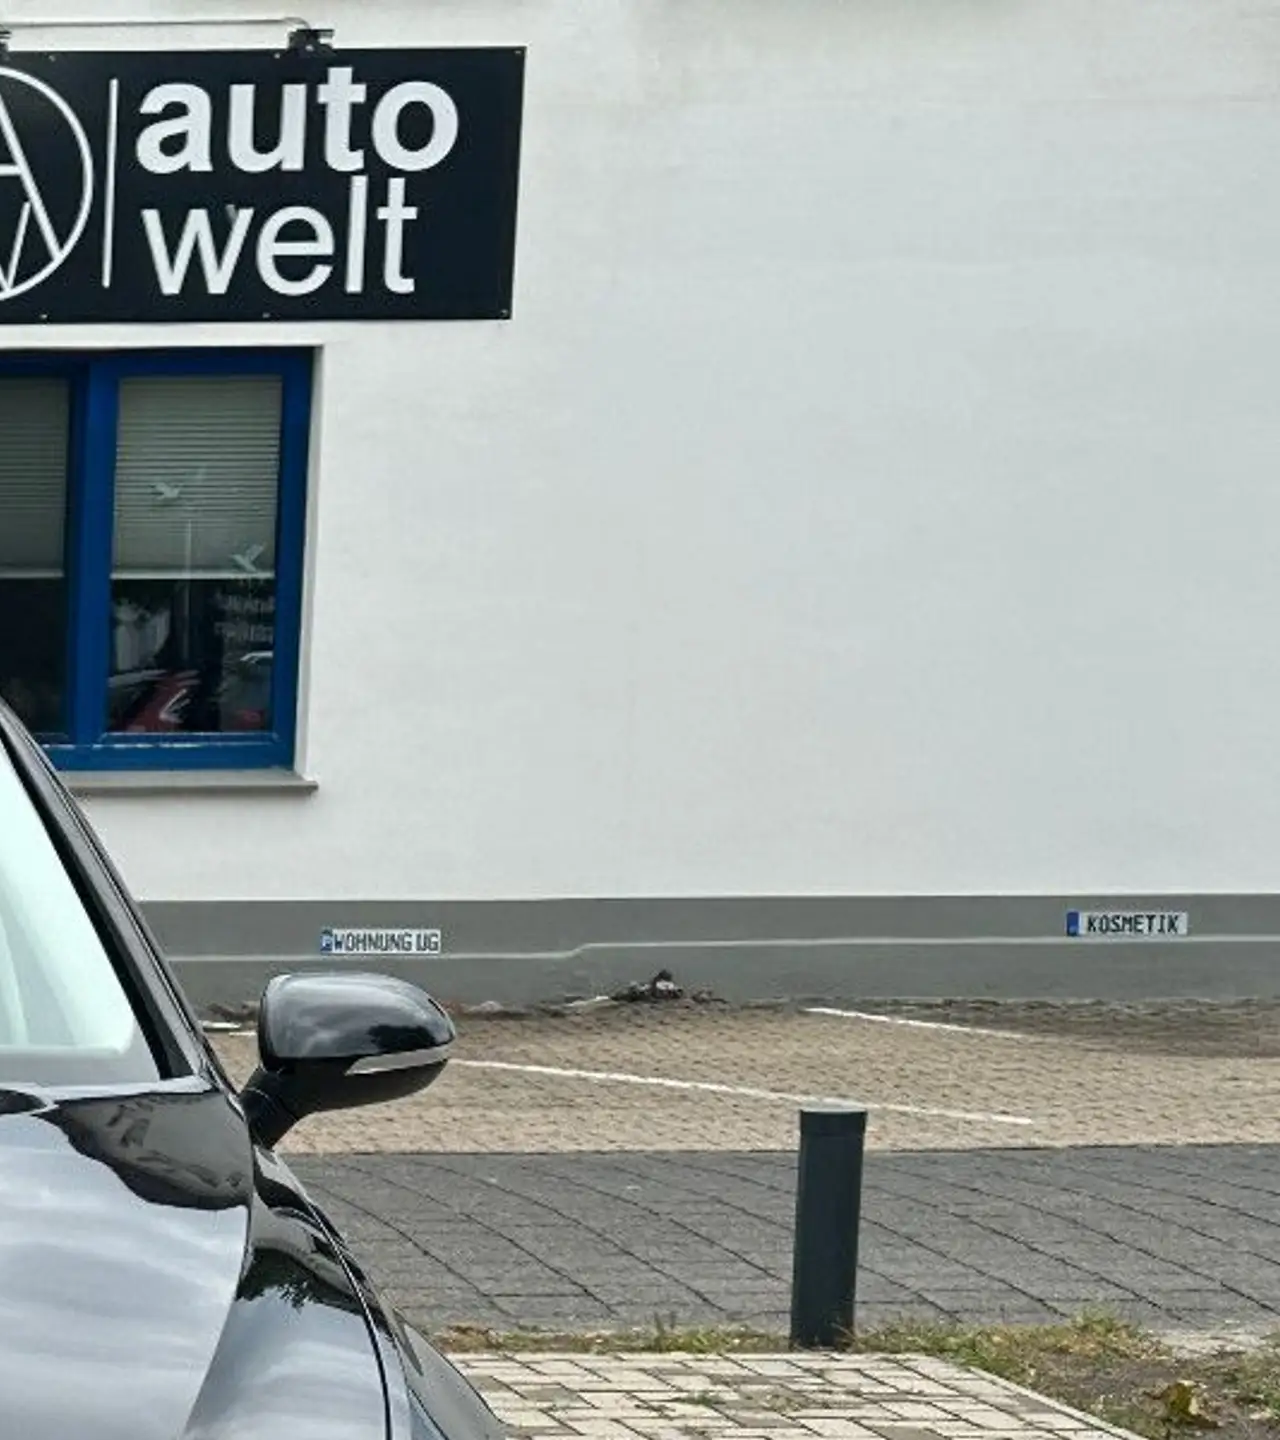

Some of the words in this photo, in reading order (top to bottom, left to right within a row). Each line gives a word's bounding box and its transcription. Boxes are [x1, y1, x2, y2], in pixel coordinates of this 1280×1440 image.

[136, 66, 459, 172] auto
[141, 175, 418, 297] welt
[334, 931, 412, 952] WOHNUNG
[1087, 913, 1179, 934] KOSMETIK
